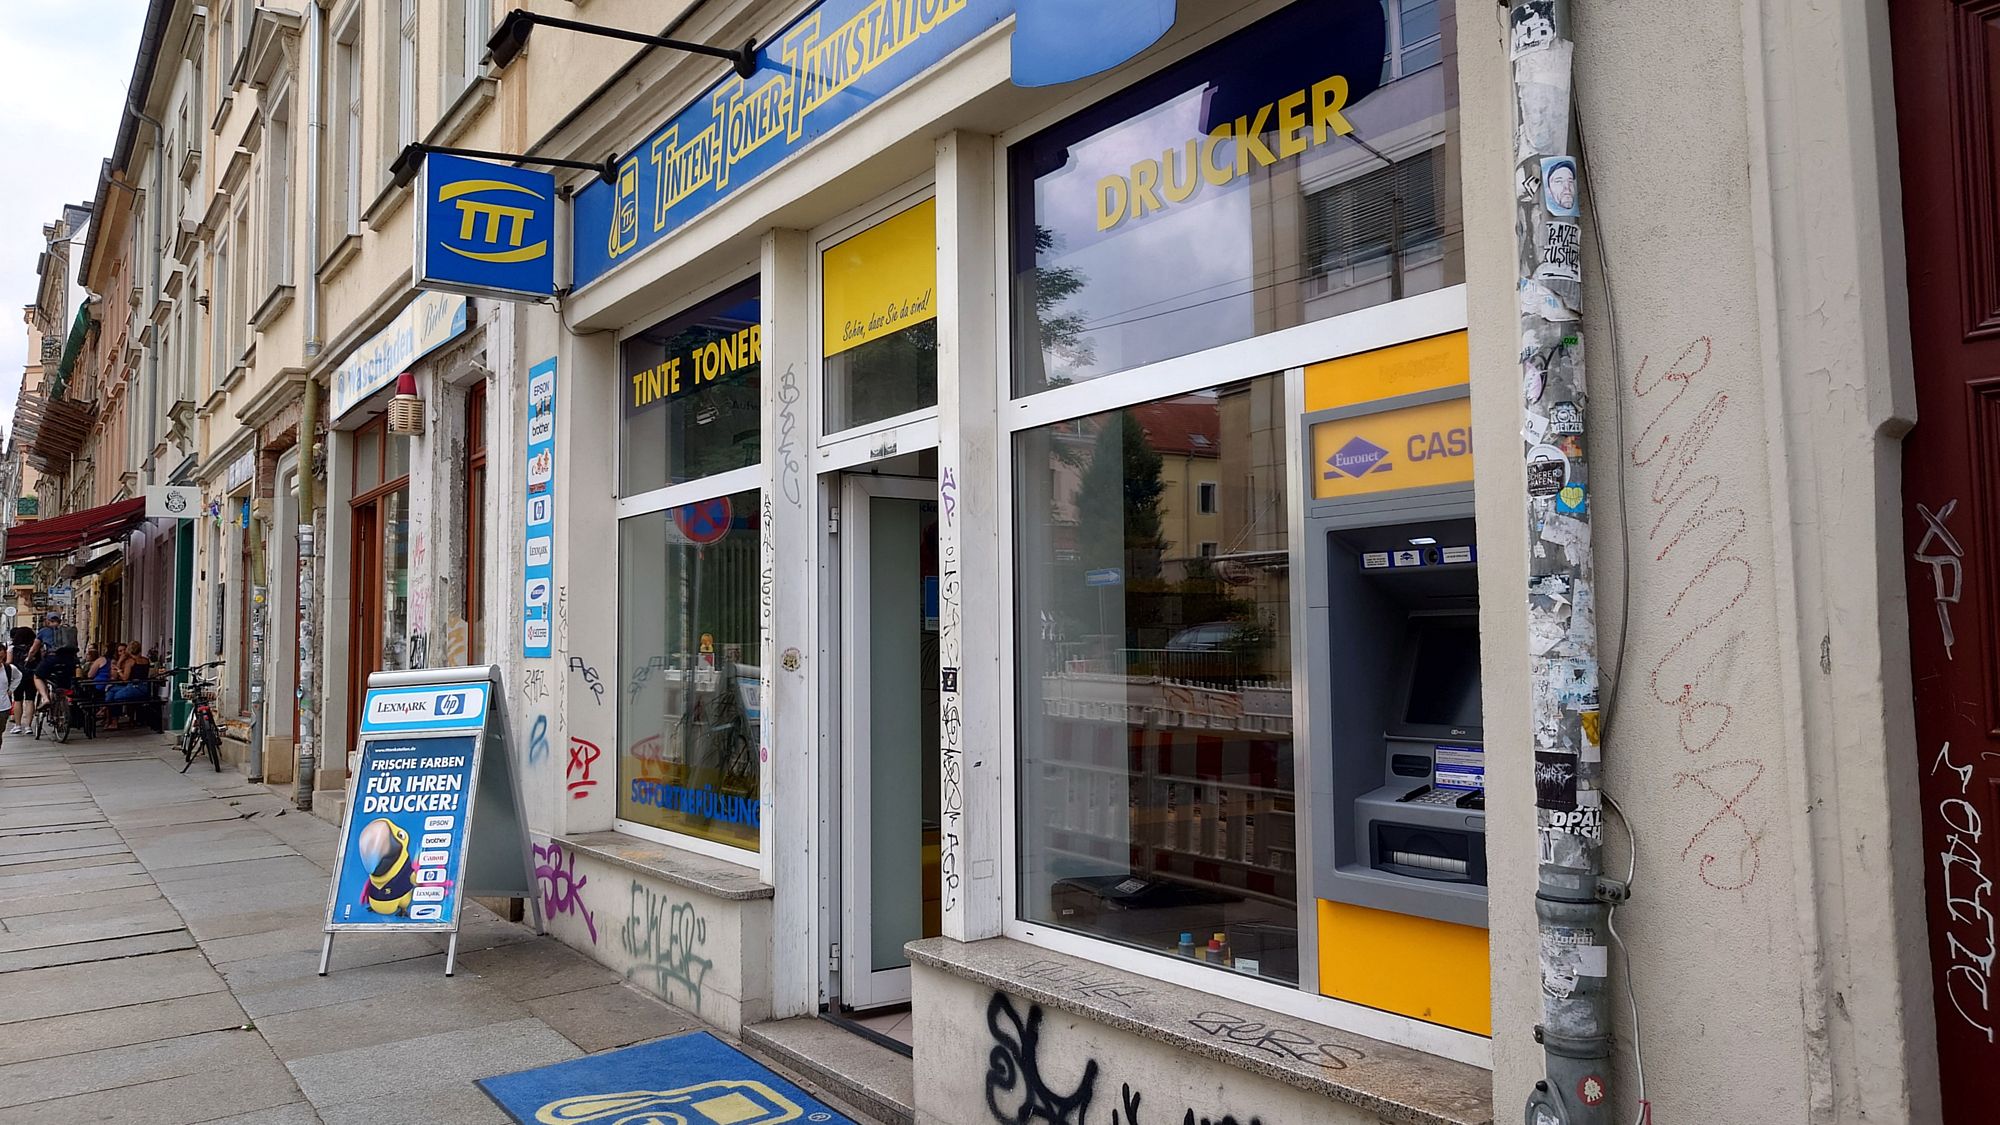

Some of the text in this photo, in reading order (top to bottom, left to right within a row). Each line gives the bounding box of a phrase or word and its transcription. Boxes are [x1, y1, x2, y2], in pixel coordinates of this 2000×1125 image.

[1095, 74, 1355, 232] DRUCKER
[455, 199, 535, 247] TTT
[868, 312, 885, 331] dass
[885, 303, 898, 325] Sie
[900, 298, 909, 319] da
[910, 287, 932, 315] sind!
[632, 324, 761, 408] TINTE TONER
[533, 380, 550, 397] EPSON
[532, 422, 550, 437] brother
[1335, 450, 1380, 467] Euronet
[377, 702, 427, 714] LEXMARK
[371, 756, 465, 771] FRISCHE FARBEN
[366, 772, 462, 794] FÜR IHREN
[363, 793, 459, 813] DRUCKER!
[631, 778, 760, 829] SOFORTBEFÜLLUNG
[429, 819, 449, 827] EPSON
